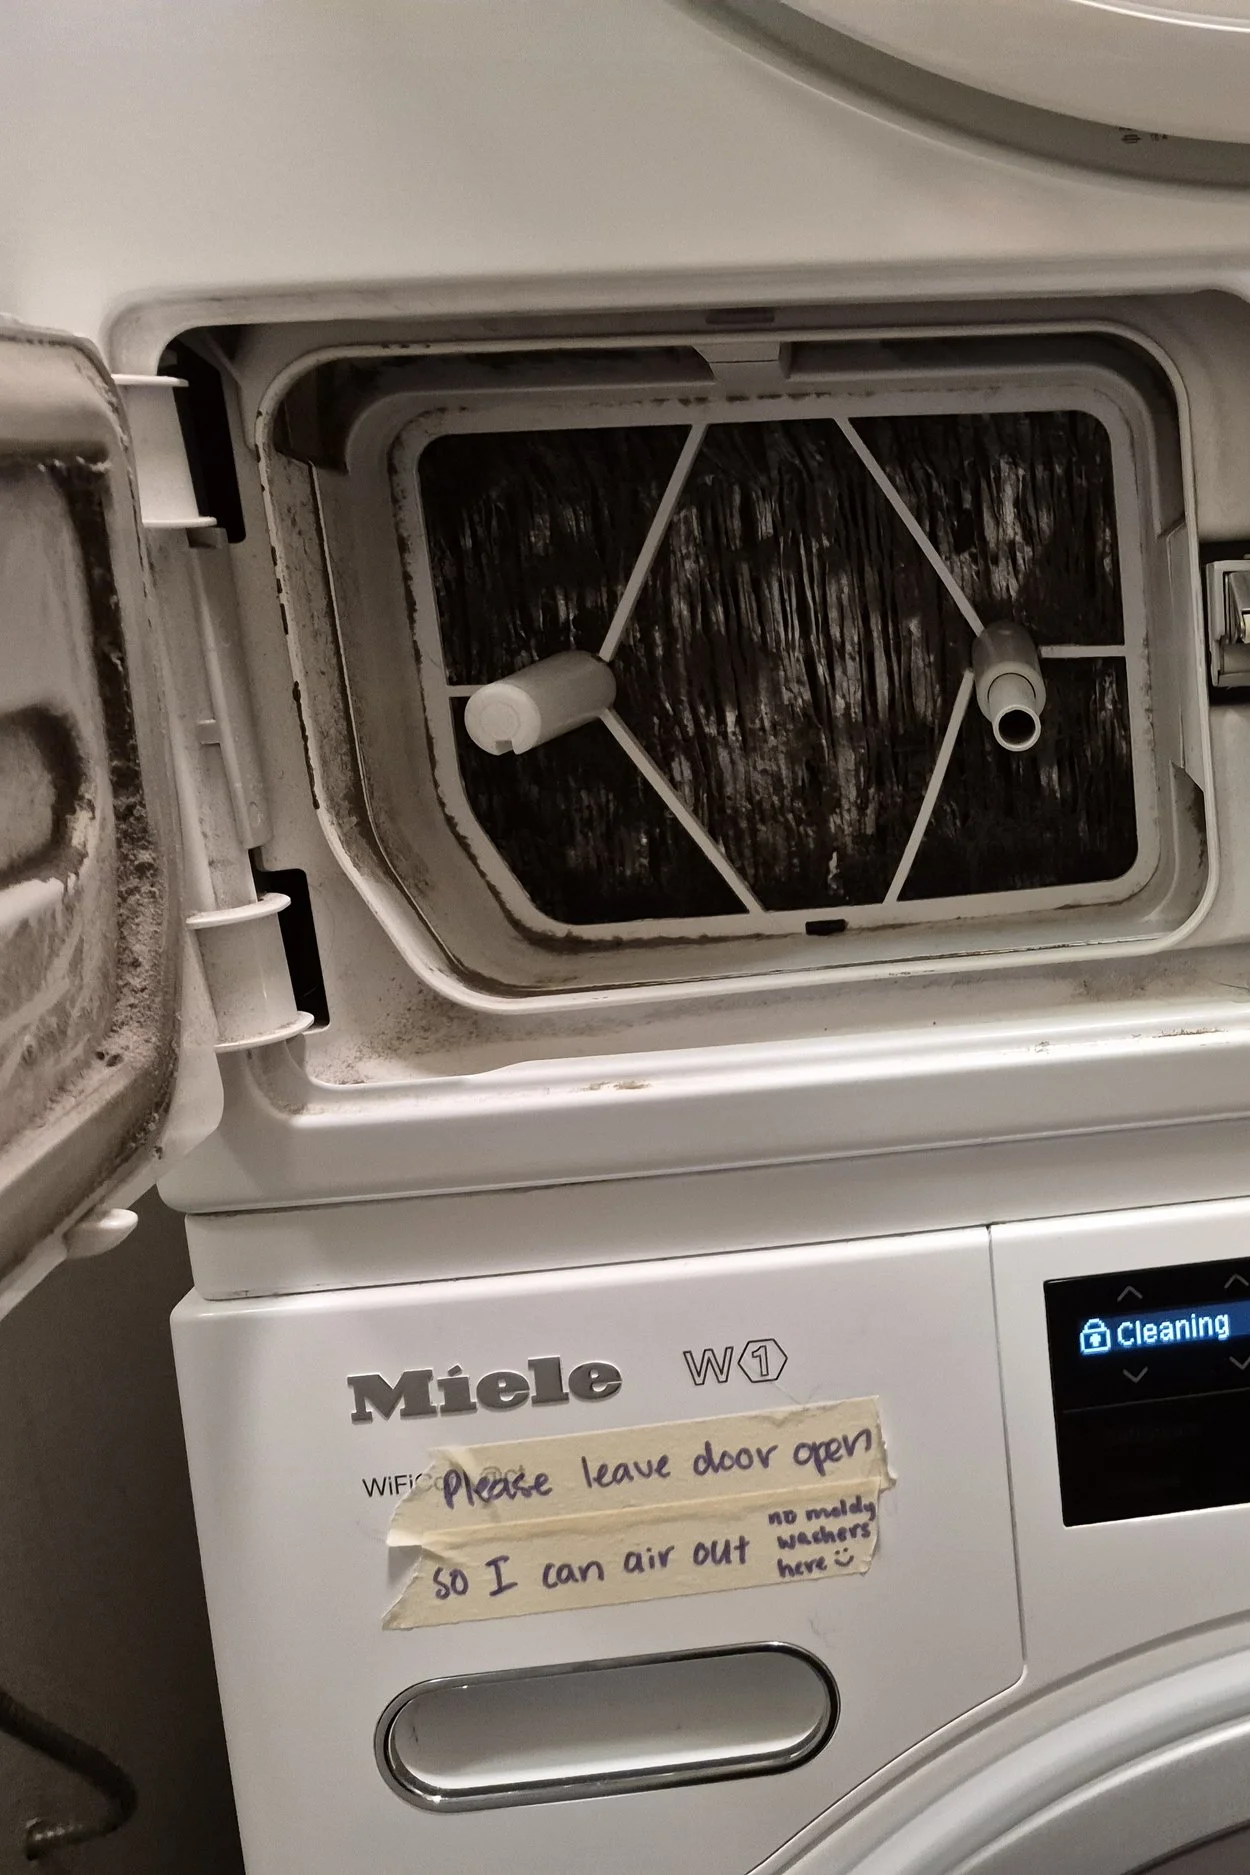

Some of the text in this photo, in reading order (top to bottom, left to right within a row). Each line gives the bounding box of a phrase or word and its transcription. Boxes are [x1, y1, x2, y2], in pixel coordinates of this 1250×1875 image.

[1117, 1309, 1230, 1347] Cleaning
[347, 1356, 623, 1423] Miele
[443, 1428, 872, 1510] Please leave door open
[768, 1499, 877, 1526] no moldy
[777, 1522, 871, 1551] washers
[487, 1555, 519, 1598] I
[542, 1558, 605, 1590] can
[623, 1546, 673, 1575] air
[693, 1537, 750, 1568] out
[777, 1556, 828, 1580] here
